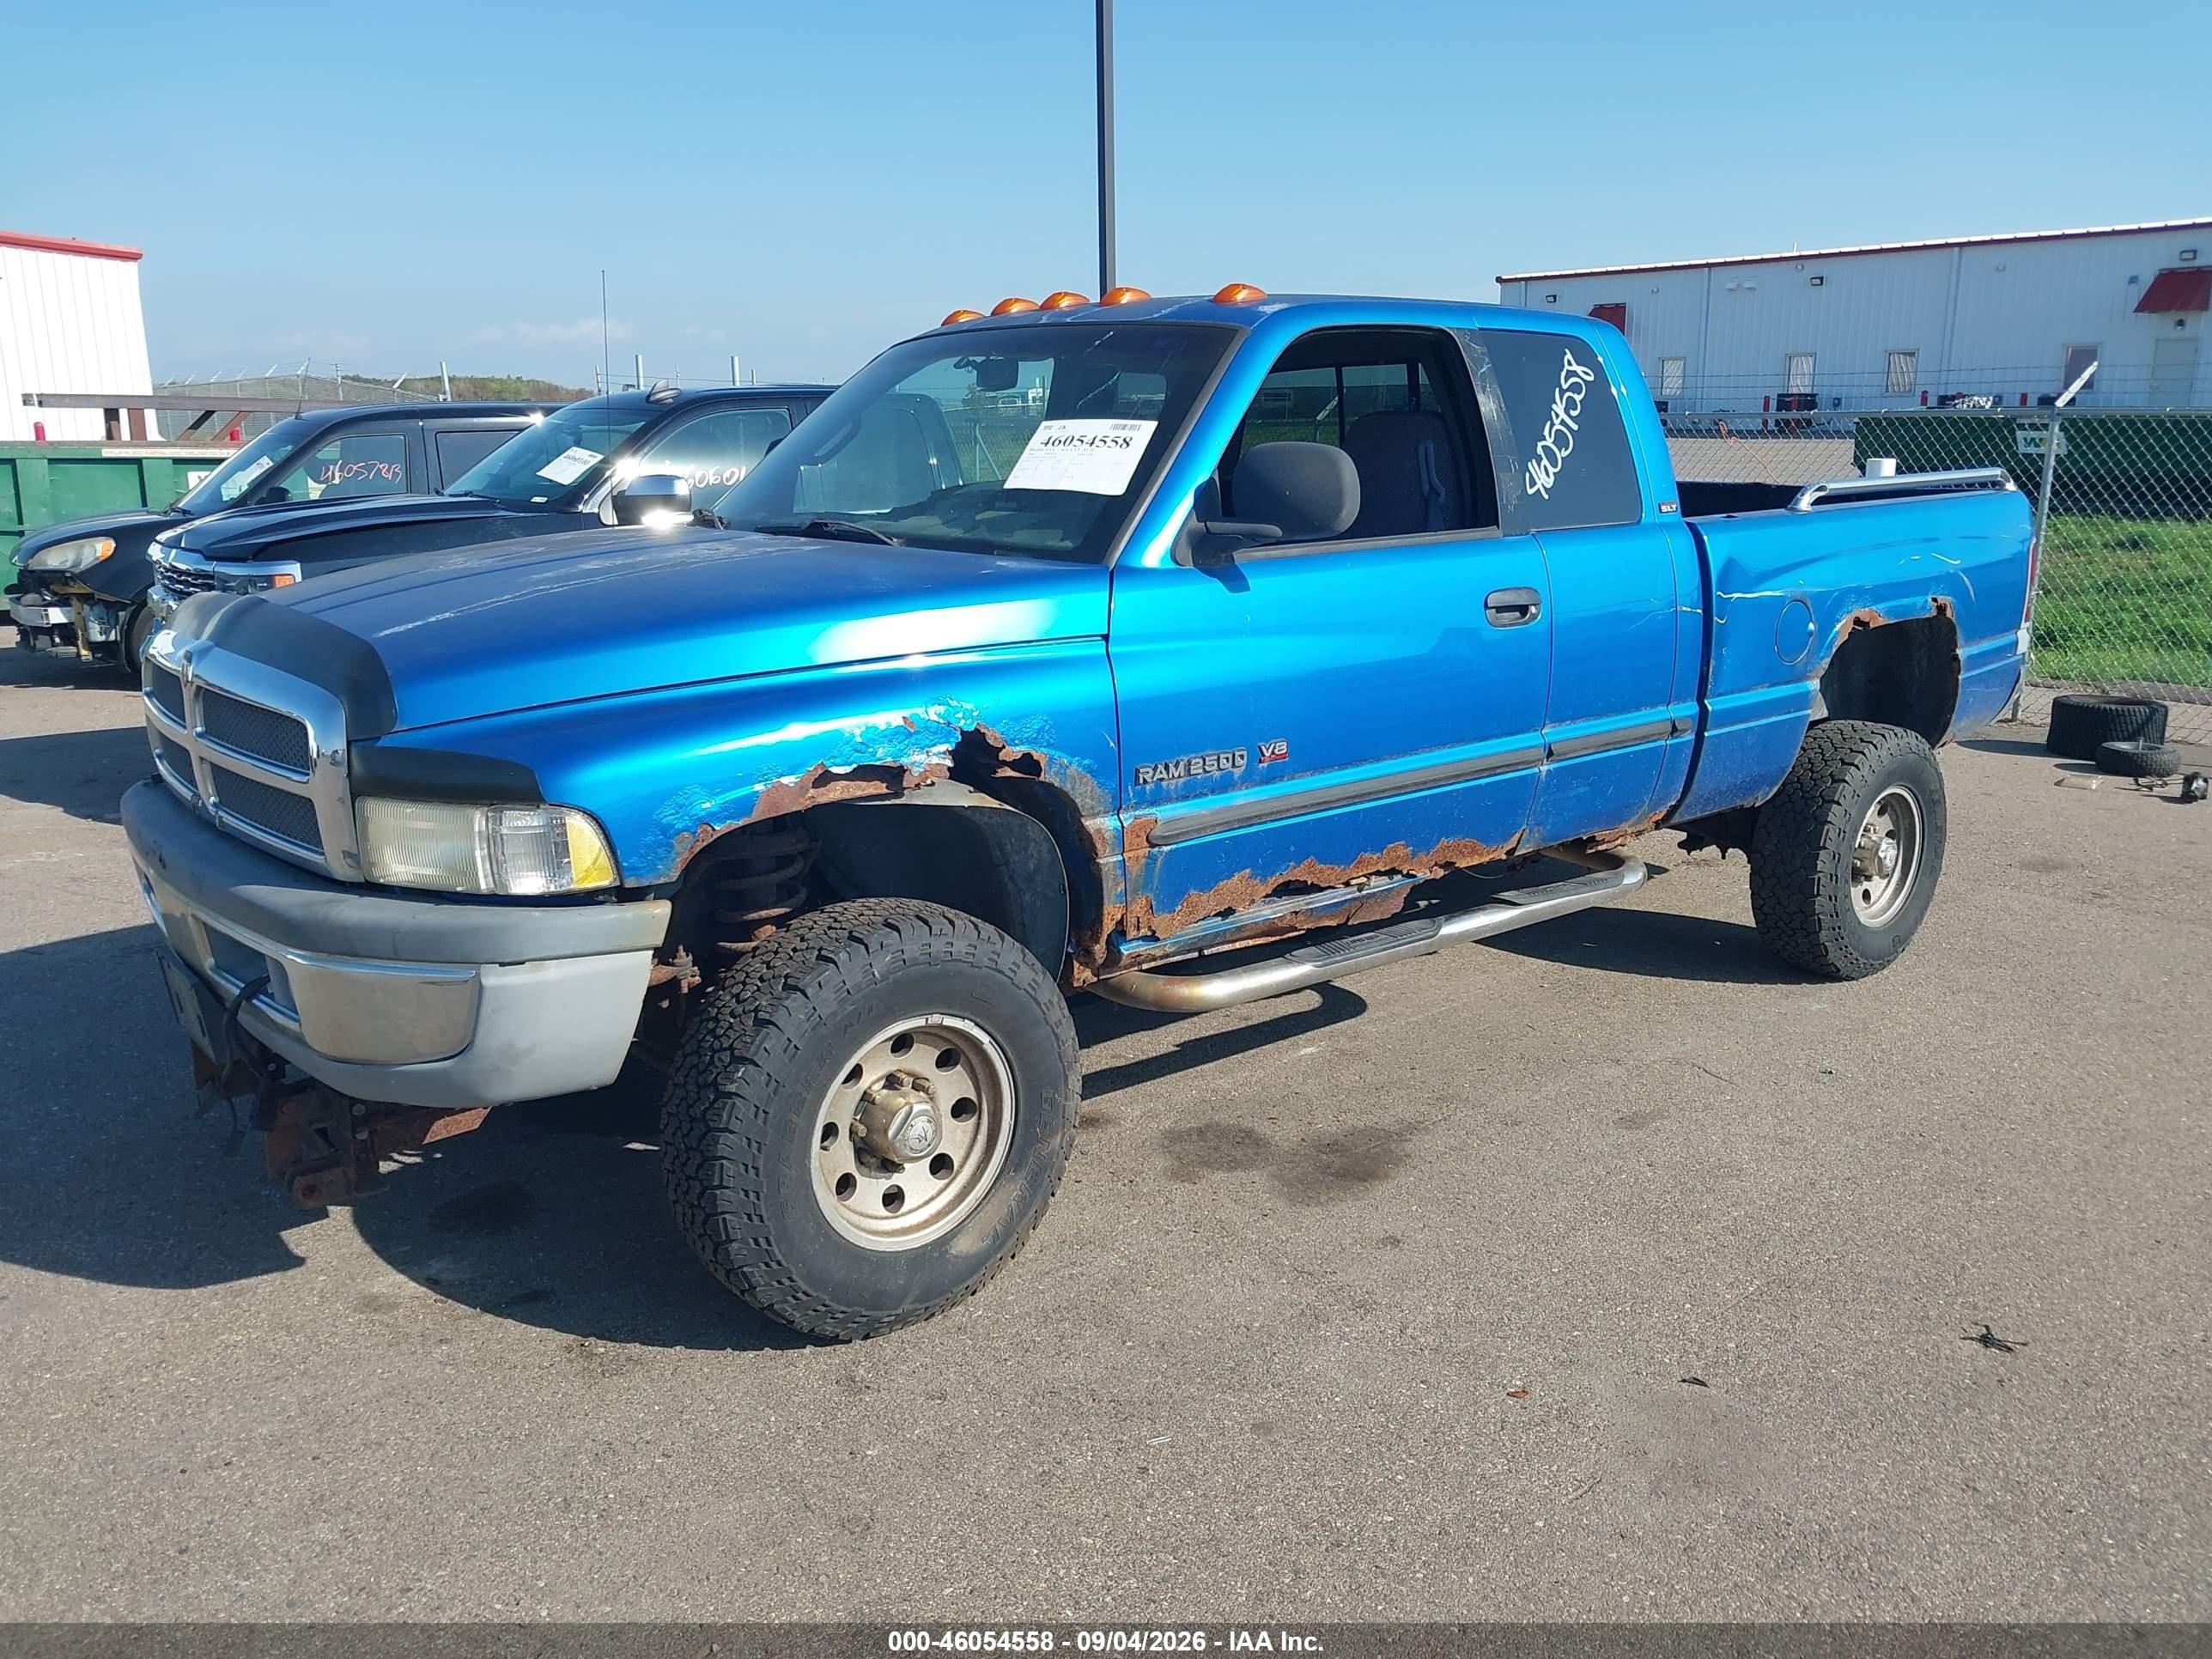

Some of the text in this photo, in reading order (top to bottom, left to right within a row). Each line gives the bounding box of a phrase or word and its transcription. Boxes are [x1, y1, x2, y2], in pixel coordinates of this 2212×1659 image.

[1525, 349, 1595, 500] 46054558
[1040, 434, 1133, 449] 46054558
[1661, 504, 1677, 513] SLT
[1259, 741, 1288, 757] V8
[1136, 749, 1247, 785] RAM 2500
[981, 1091, 1057, 1246] GENERAL
